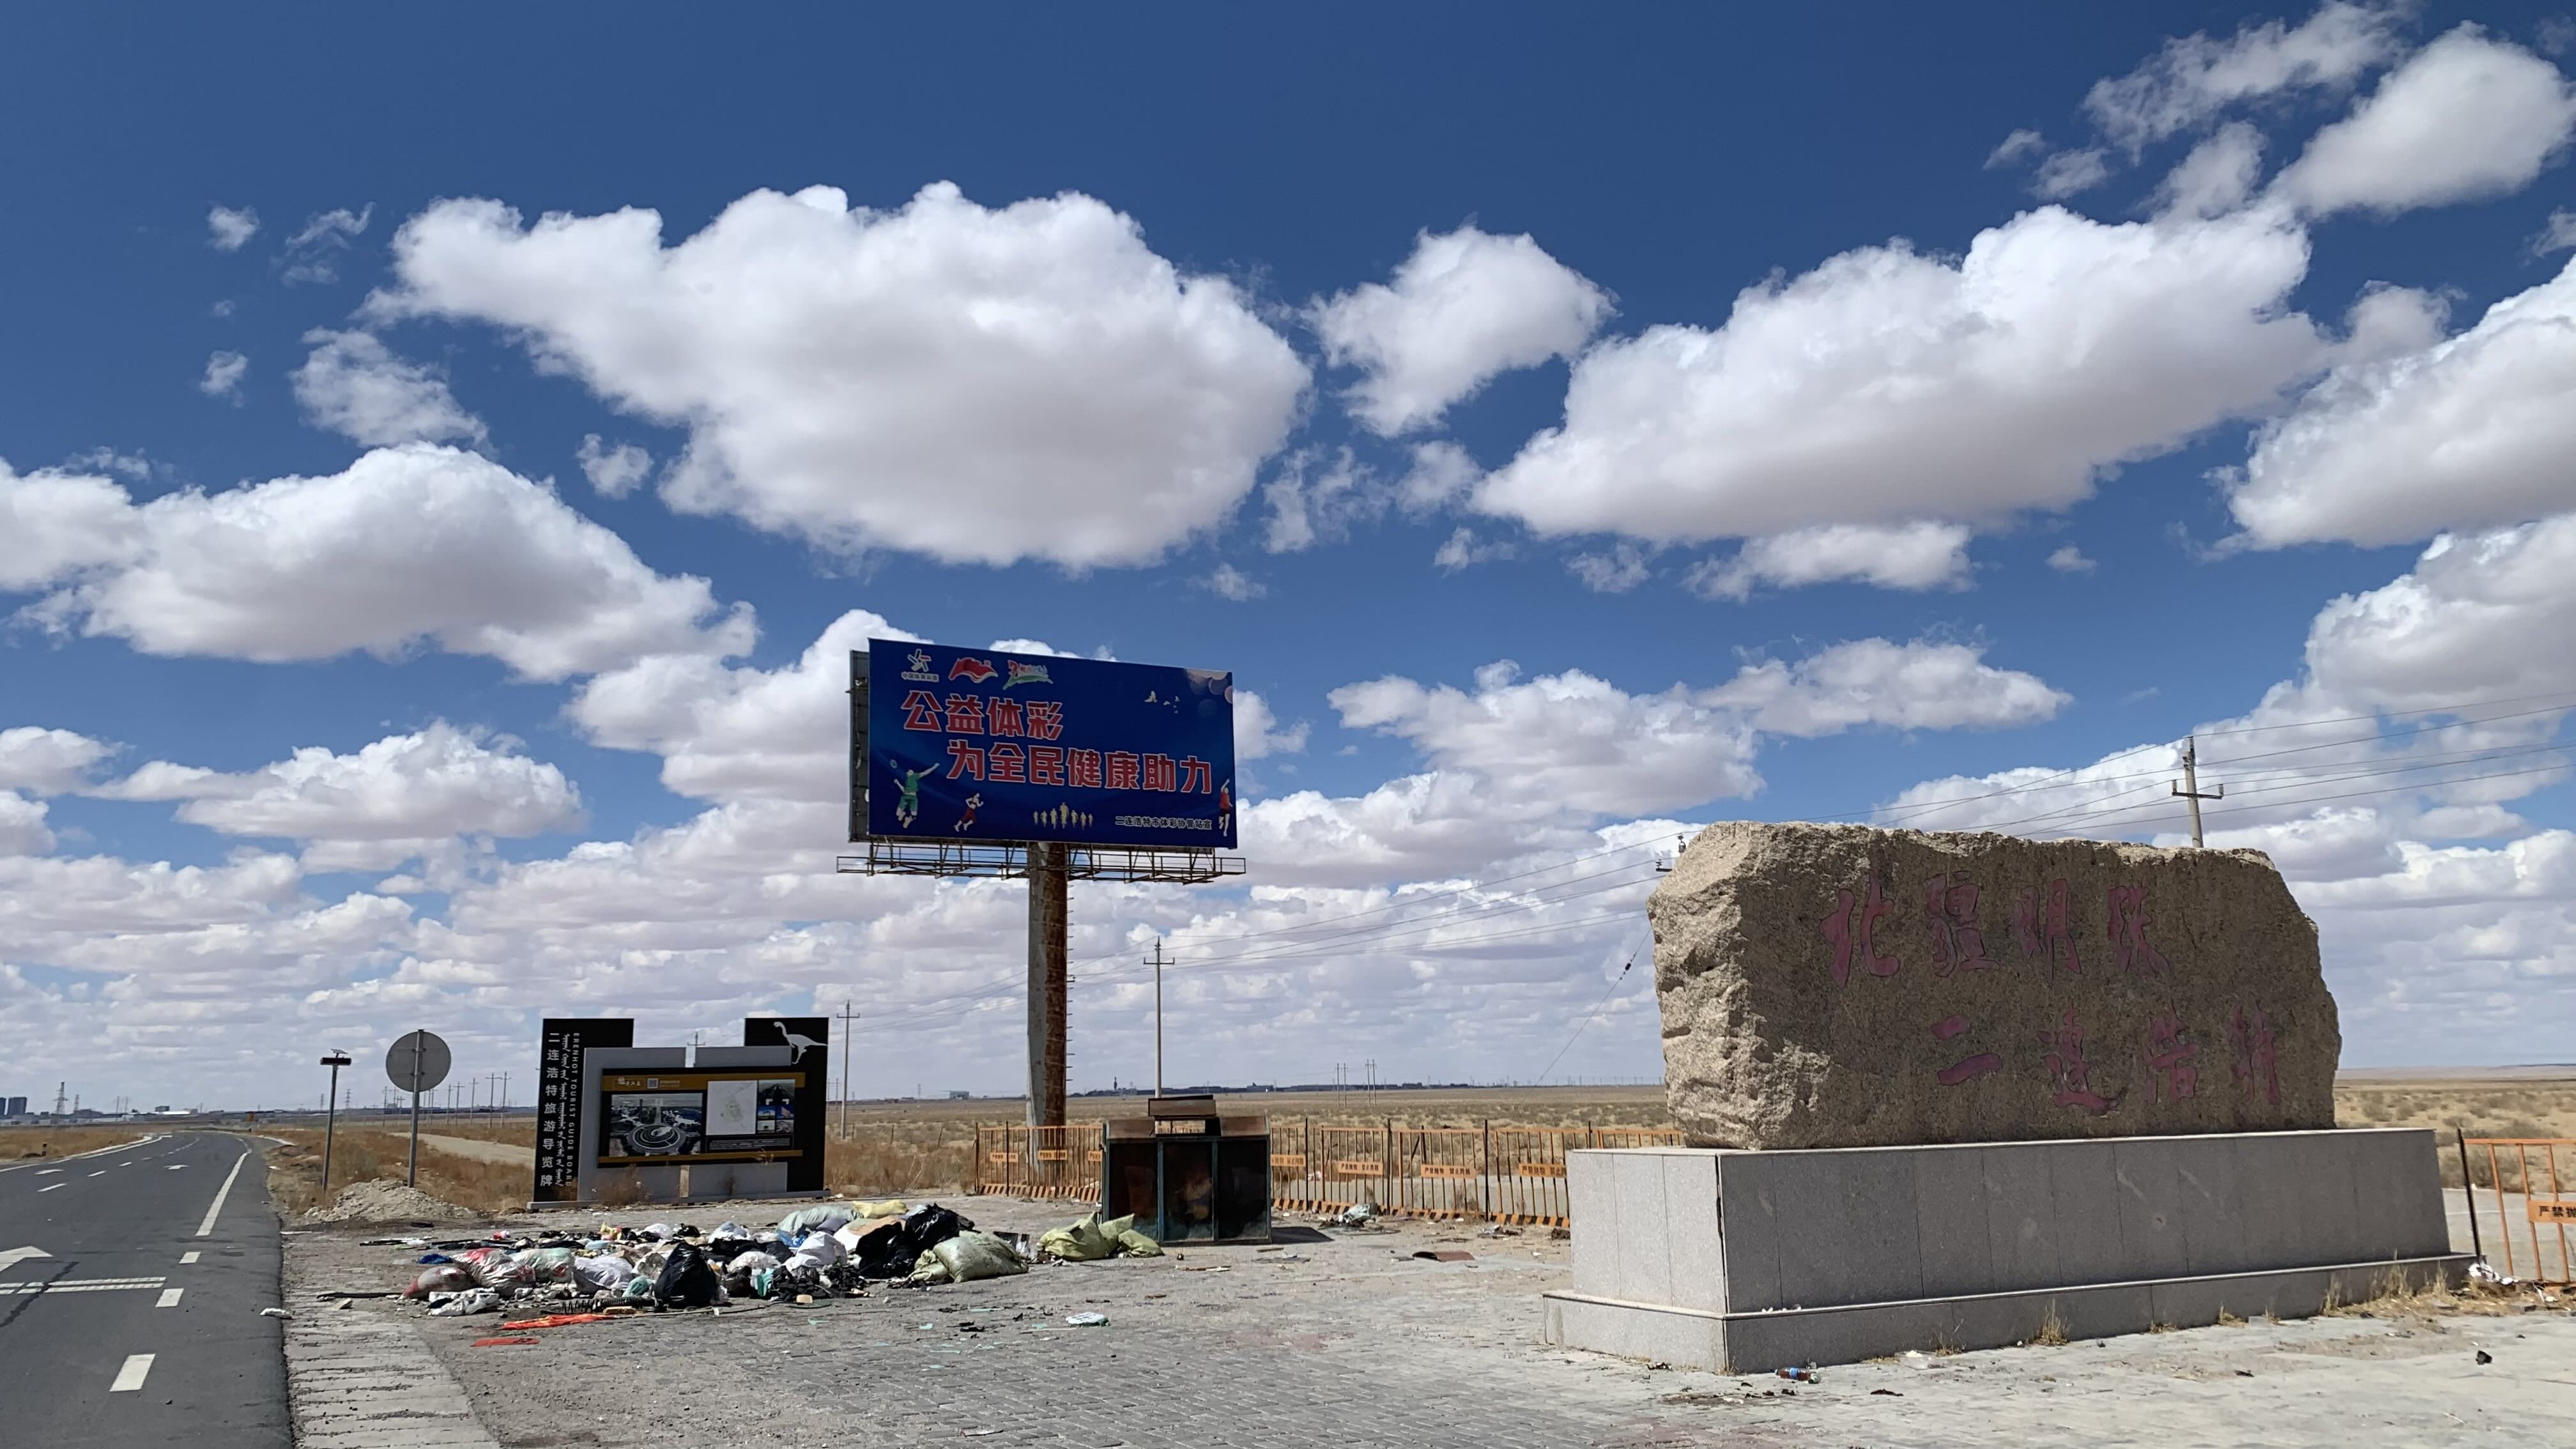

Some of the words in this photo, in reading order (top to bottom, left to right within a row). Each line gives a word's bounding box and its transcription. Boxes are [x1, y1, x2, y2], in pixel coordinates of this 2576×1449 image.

[901, 689, 1064, 741] 公益体彩
[946, 739, 1213, 794] 为全民健康助力
[571, 1032, 580, 1074] ERENHOT
[540, 1032, 560, 1186] 二连浩特旅游导览牌
[569, 1078, 578, 1117] TOURIST
